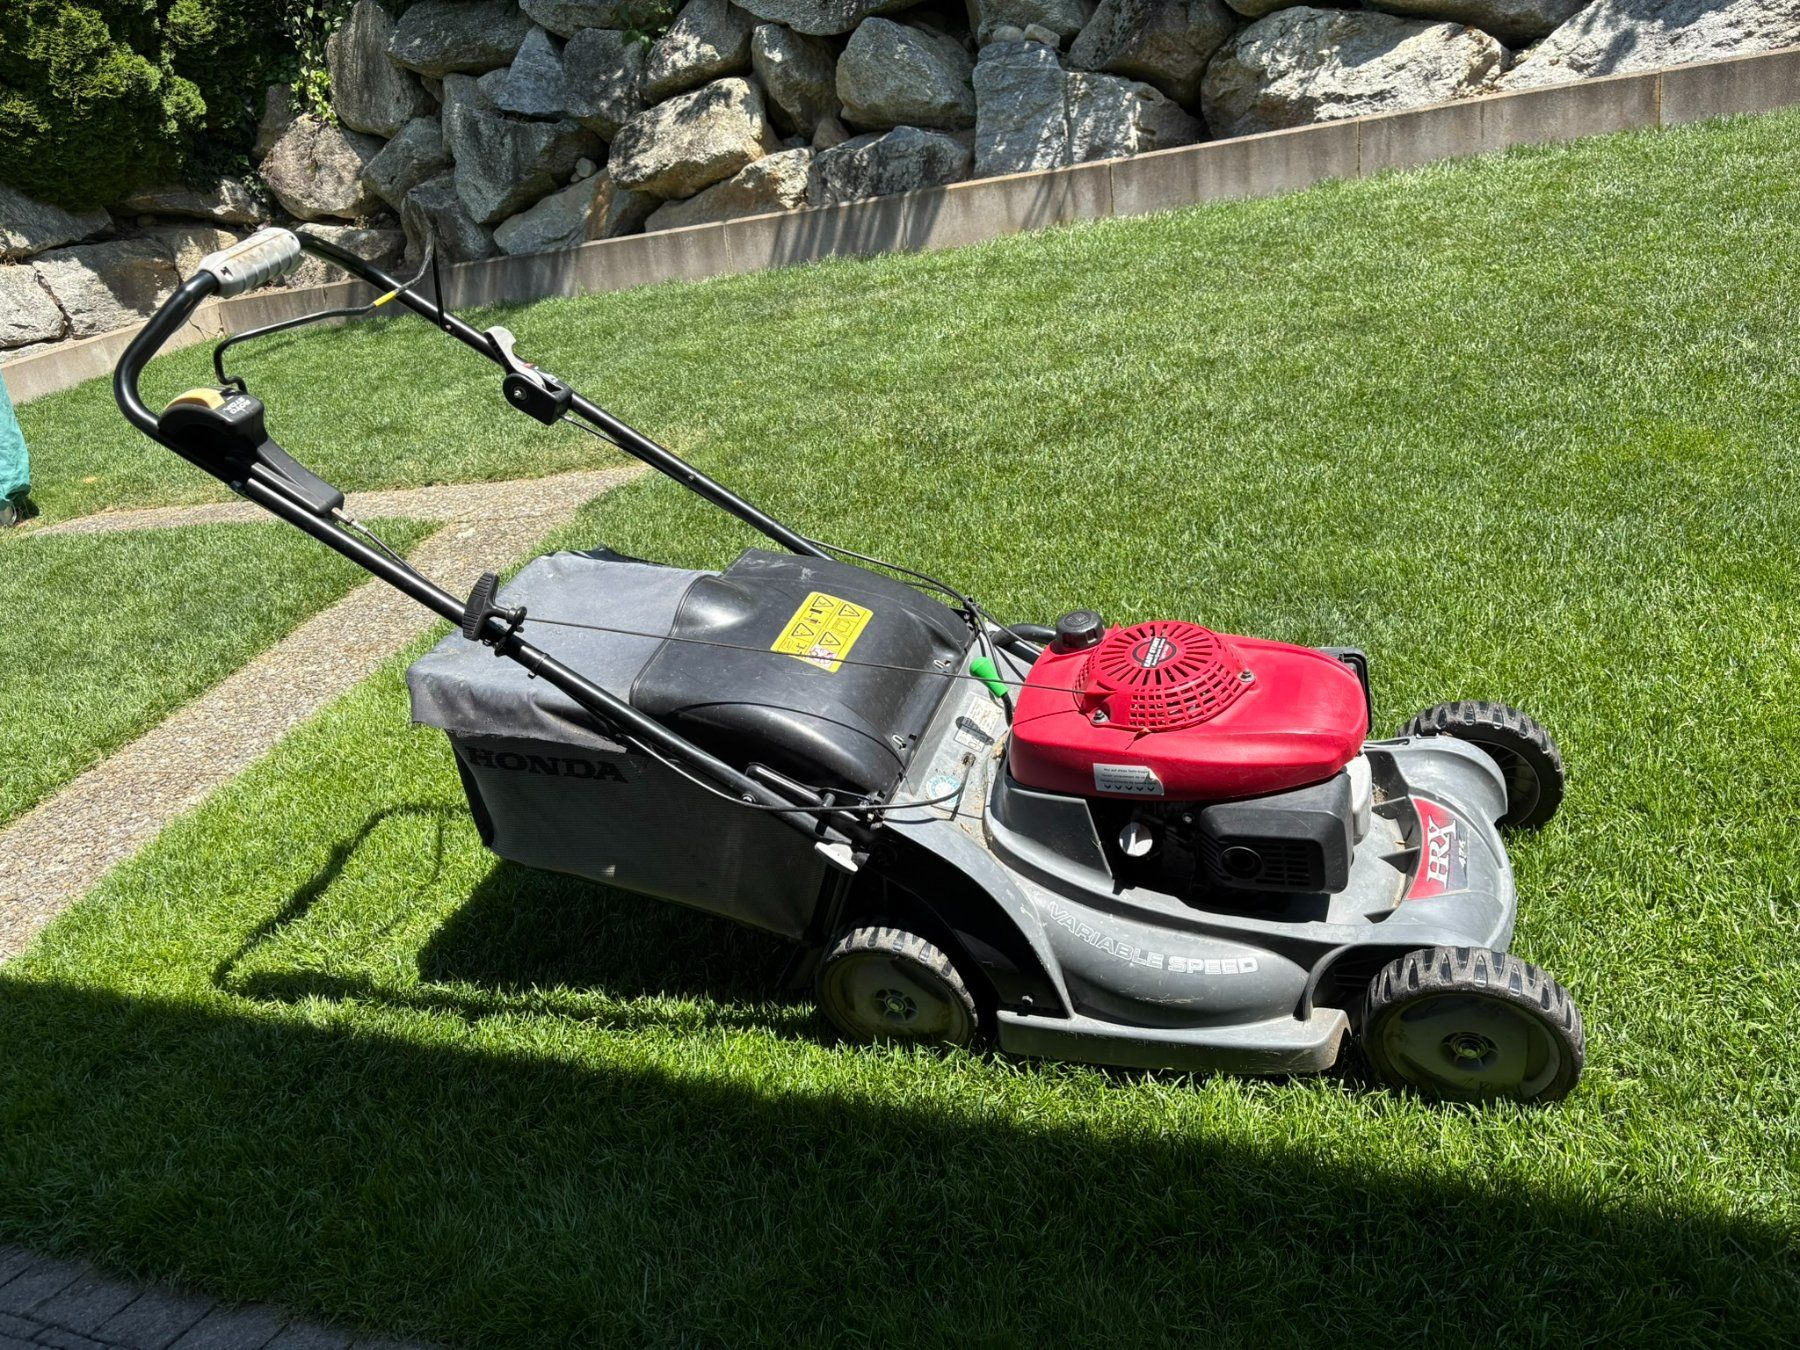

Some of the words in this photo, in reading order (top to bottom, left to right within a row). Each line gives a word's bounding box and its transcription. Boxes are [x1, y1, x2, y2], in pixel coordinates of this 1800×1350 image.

[465, 746, 629, 783] HONDA
[1426, 814, 1457, 890] HRX
[1050, 901, 1164, 970] VARIABLE
[1167, 955, 1259, 975] SPEED
